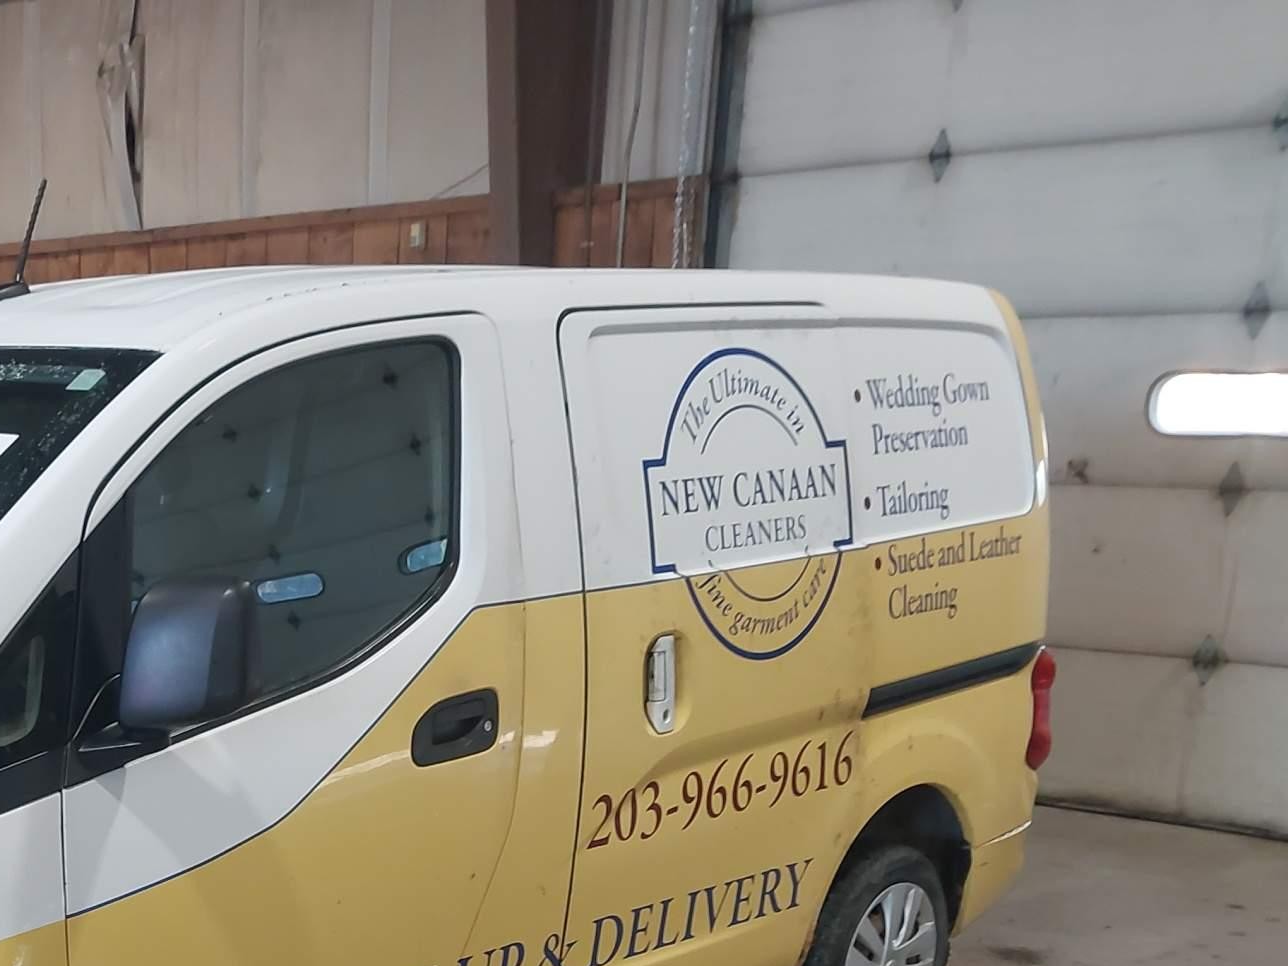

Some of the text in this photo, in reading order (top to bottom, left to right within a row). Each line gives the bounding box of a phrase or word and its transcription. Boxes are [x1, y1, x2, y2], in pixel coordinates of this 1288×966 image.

[680, 367, 805, 444] The Ultimate in
[866, 372, 990, 417] Wedding Gown
[872, 418, 969, 455] Preservation
[659, 463, 837, 516] NEW CANAAN
[877, 480, 950, 520] Tailoring
[705, 513, 807, 552] CLEANERS
[887, 525, 1022, 577] Suede and Leather
[695, 574, 732, 617] fine
[728, 601, 800, 637] garment
[888, 582, 958, 620] Cleaning
[586, 730, 855, 850] 203-966-9616
